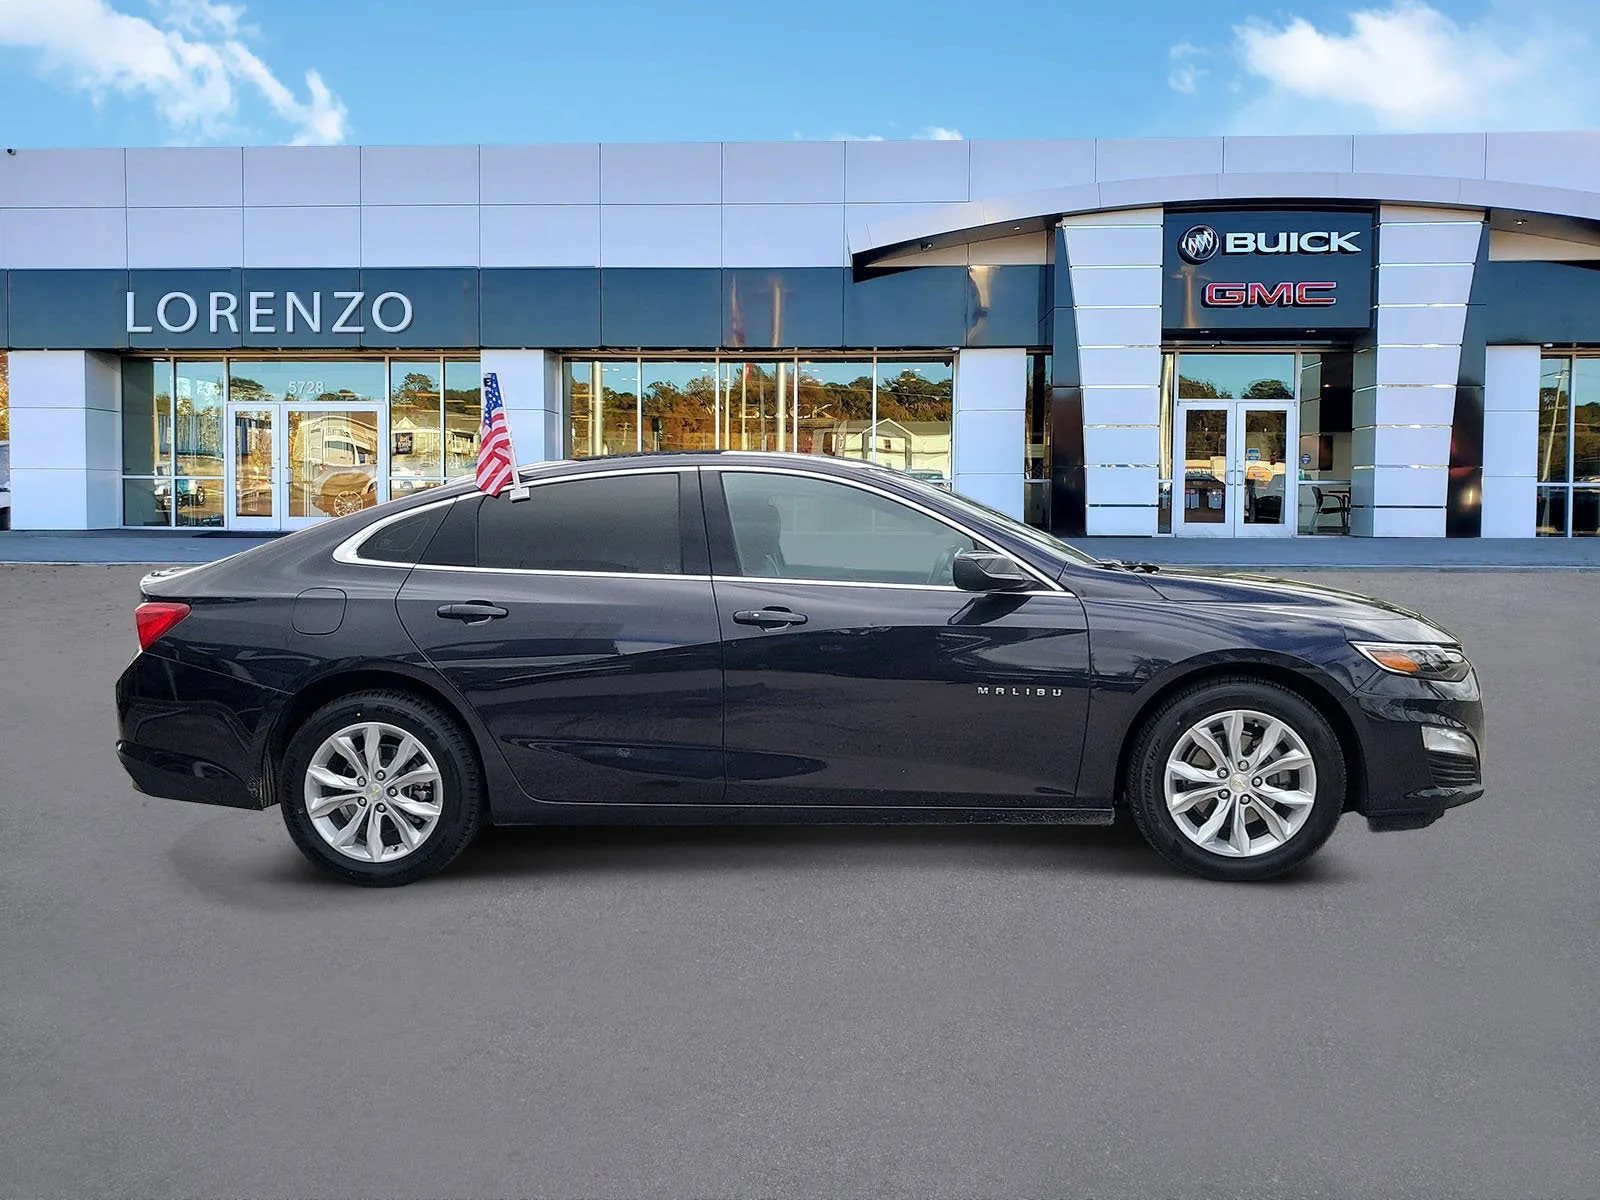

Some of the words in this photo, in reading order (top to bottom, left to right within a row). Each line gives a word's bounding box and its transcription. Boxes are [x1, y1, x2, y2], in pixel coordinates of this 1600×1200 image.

[1225, 231, 1362, 253] BUICK
[1206, 281, 1337, 305] GMC
[126, 291, 414, 333] LORENZO
[288, 380, 325, 394] 5728
[739, 403, 835, 419] BUCK
[977, 686, 1063, 697] MALIBU
